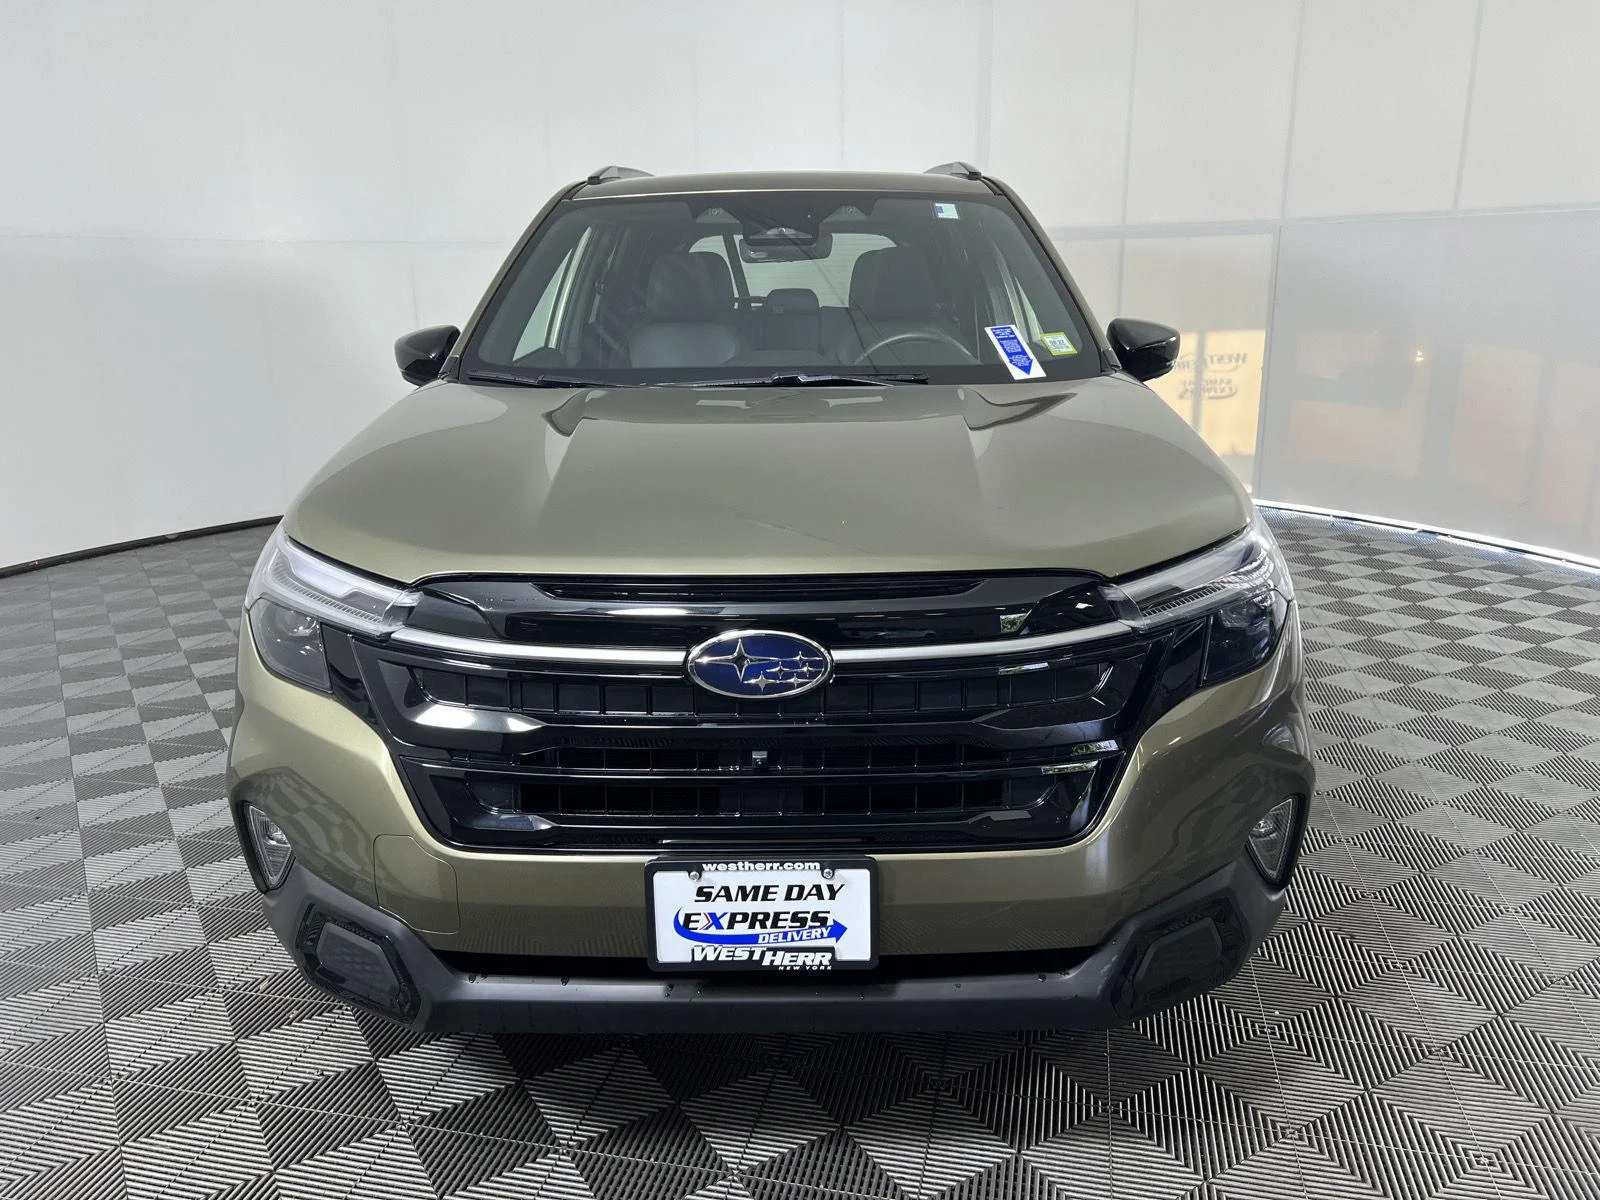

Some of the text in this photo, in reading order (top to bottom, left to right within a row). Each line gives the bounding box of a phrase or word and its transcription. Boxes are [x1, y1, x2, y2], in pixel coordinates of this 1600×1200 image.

[702, 861, 821, 872] westherr.com
[694, 883, 846, 903] SAME DAY
[682, 910, 831, 931] EXPRESS
[757, 926, 832, 945] DELIVERY
[691, 945, 833, 967] WEST HERR
